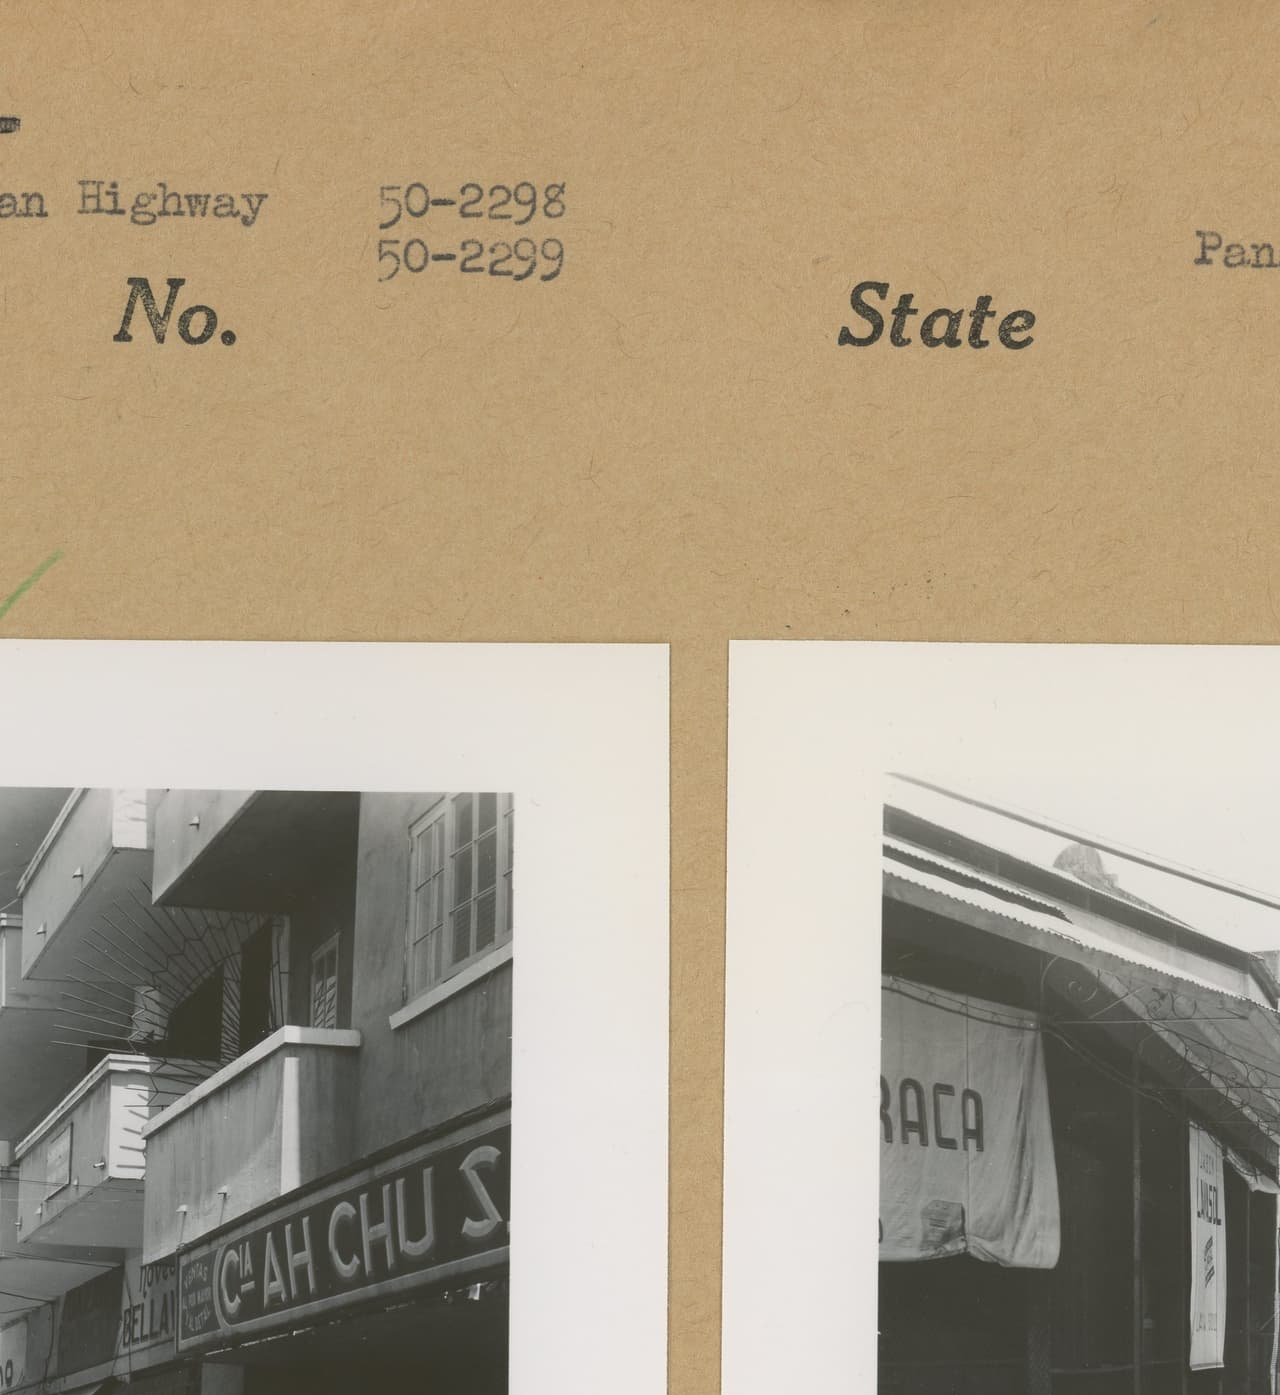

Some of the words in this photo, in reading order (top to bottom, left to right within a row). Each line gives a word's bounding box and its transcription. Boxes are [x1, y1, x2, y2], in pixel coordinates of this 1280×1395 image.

[77, 179, 269, 228] Highway
[378, 181, 566, 229] 50-2298
[377, 237, 564, 282] 50-2299
[112, 276, 237, 347] No.
[837, 280, 1037, 351] State
[263, 1216, 316, 1309] AH
[328, 1168, 433, 1277] CHU
